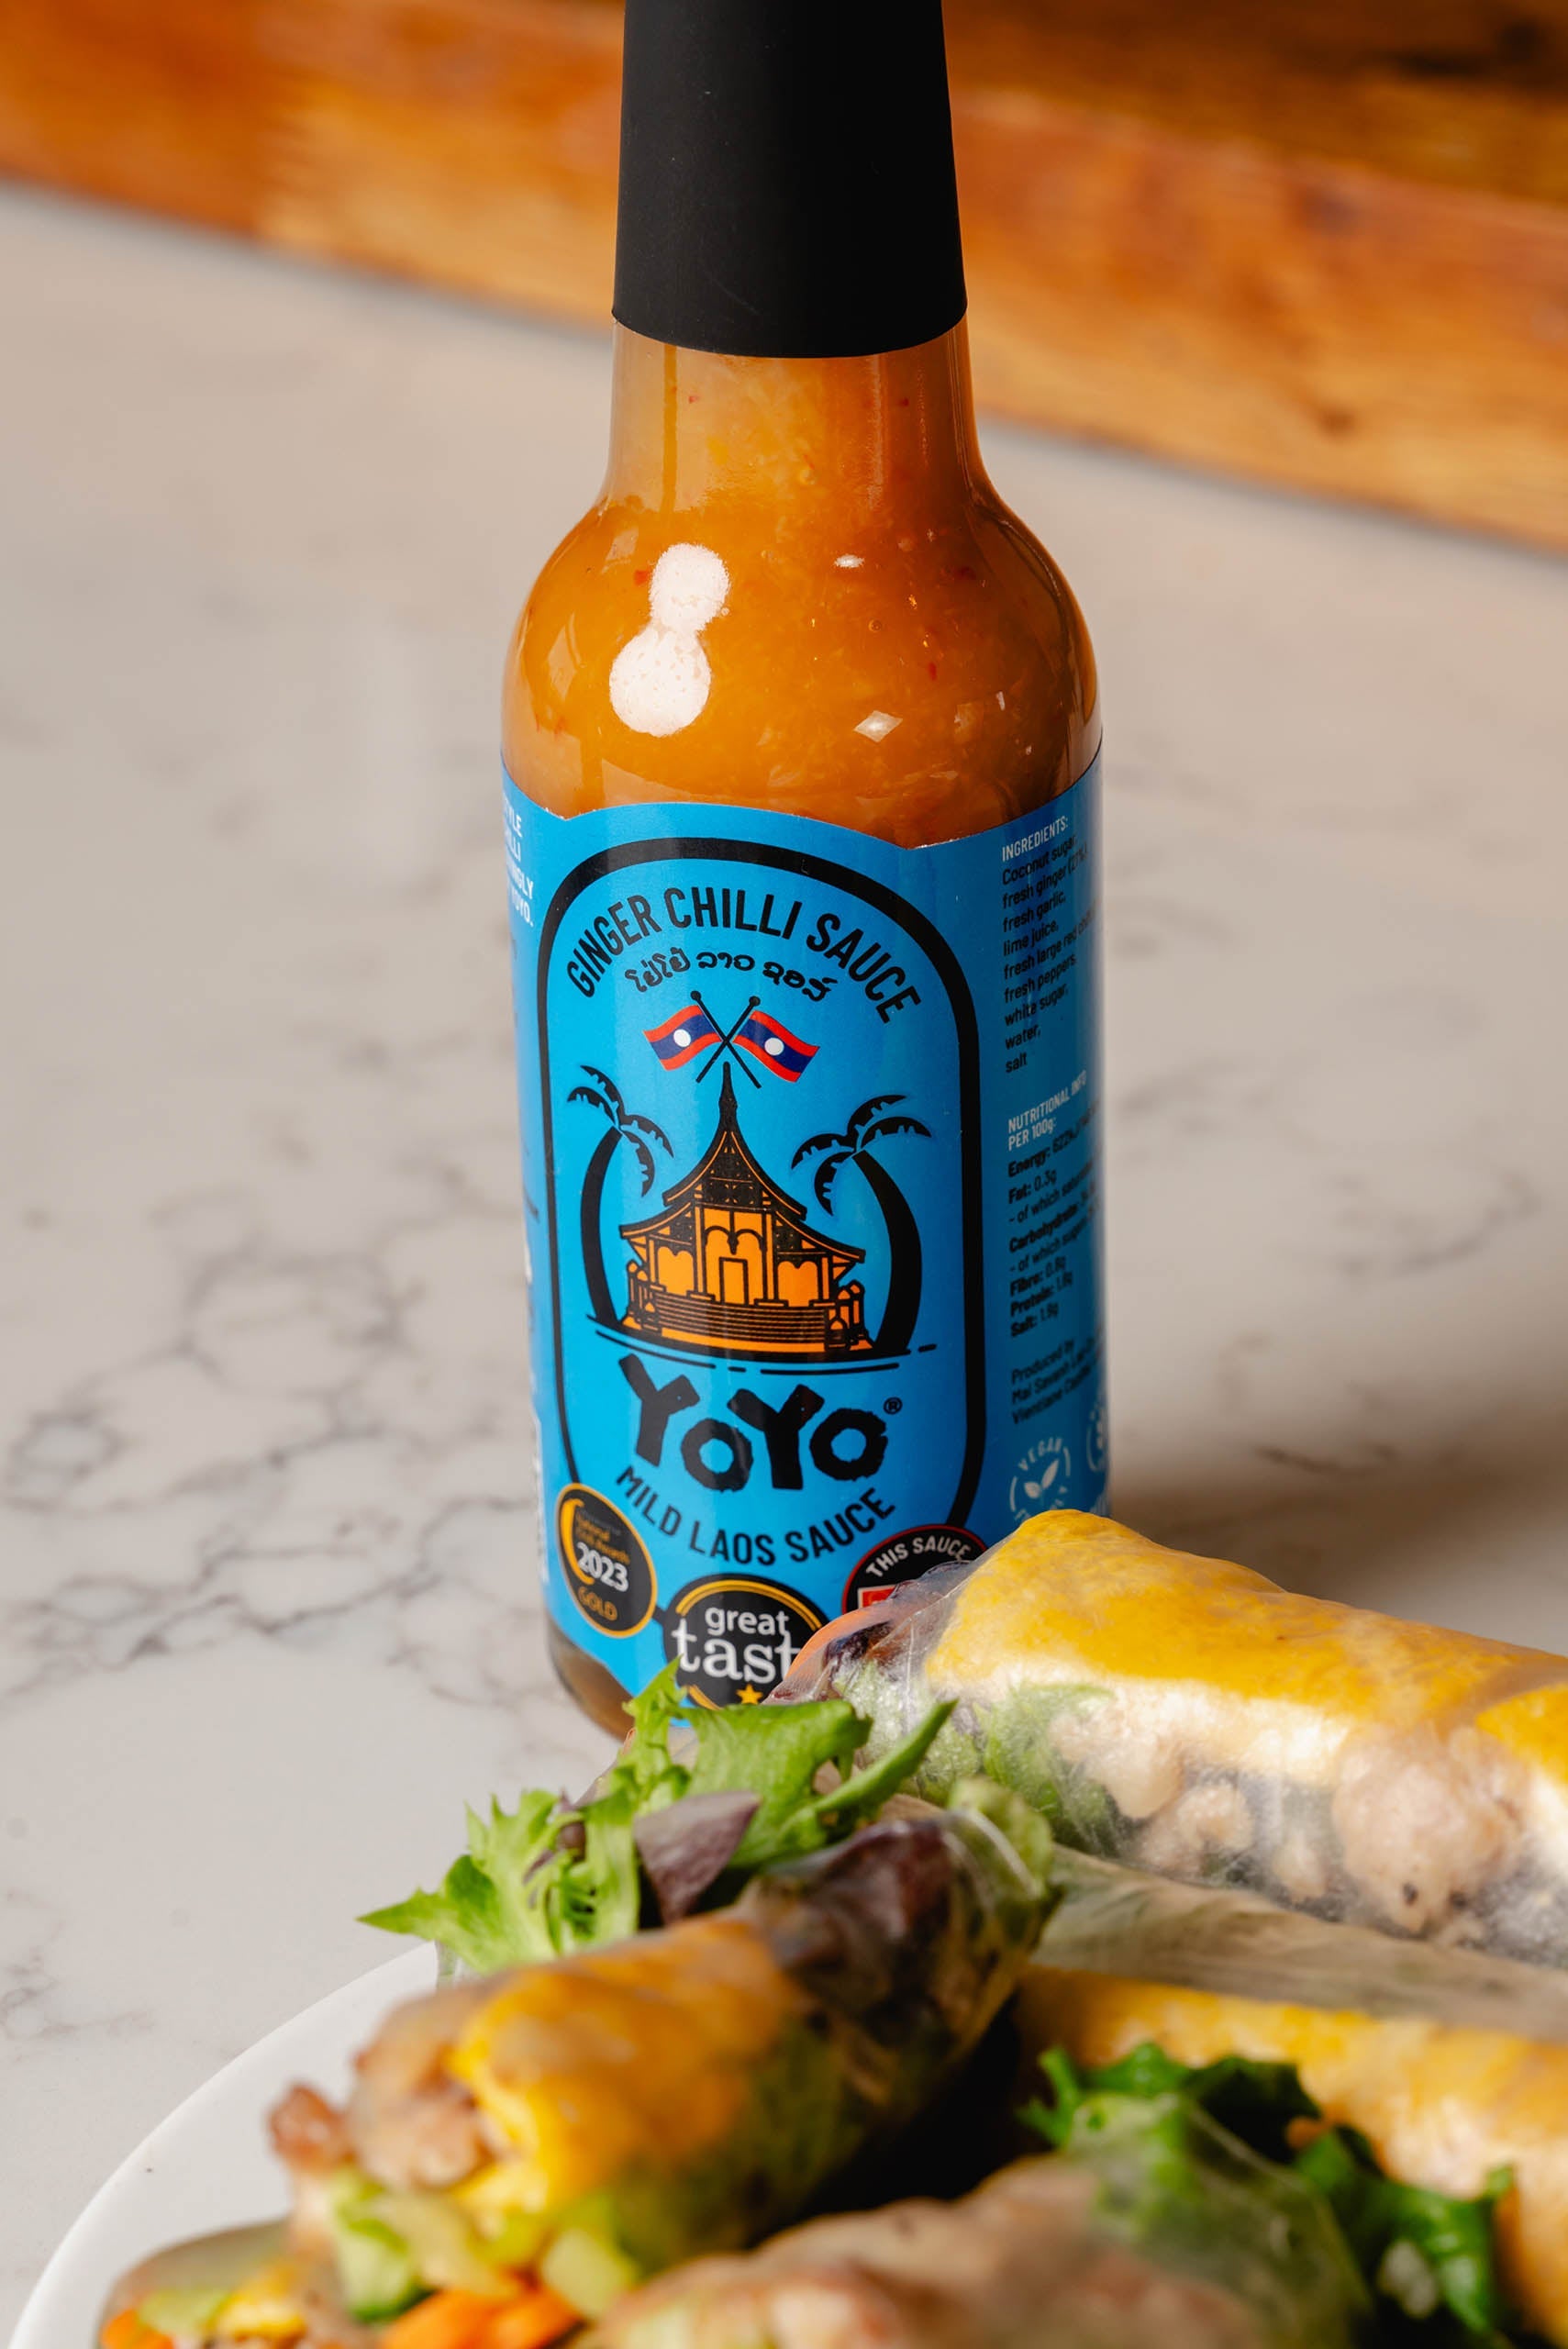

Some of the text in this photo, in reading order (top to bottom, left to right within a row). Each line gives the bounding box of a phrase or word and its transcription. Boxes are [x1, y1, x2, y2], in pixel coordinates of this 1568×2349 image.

[1002, 815, 1068, 862] INGREDIENTS:
[1003, 852, 1050, 885] Coconut
[1003, 884, 1034, 909] fresh
[1037, 865, 1066, 896] ginger
[1003, 907, 1034, 932] fresh
[567, 895, 662, 998] GINGER
[663, 886, 803, 941] CHILLI
[806, 913, 922, 1024] SAUCE
[1004, 935, 1029, 956] lime
[1004, 955, 1035, 980] fresh
[1038, 940, 1062, 964] large
[1005, 978, 1035, 1003] fresh
[1005, 1002, 1037, 1026] white
[1006, 1024, 1041, 1050] water,
[1006, 1052, 1027, 1074] salt
[1008, 1086, 1070, 1133] NUTRITIONAL
[1008, 1129, 1029, 1152] PER
[1008, 1184, 1031, 1205] Fat:
[616, 1465, 682, 1536] MILD
[690, 1520, 775, 1565] LAOS
[785, 1487, 895, 1563] SAUCE
[576, 1541, 629, 1592] 2023
[865, 1535, 973, 1578] THIS SAUCE
[705, 1607, 790, 1636] great
[671, 1618, 802, 1685] tast
